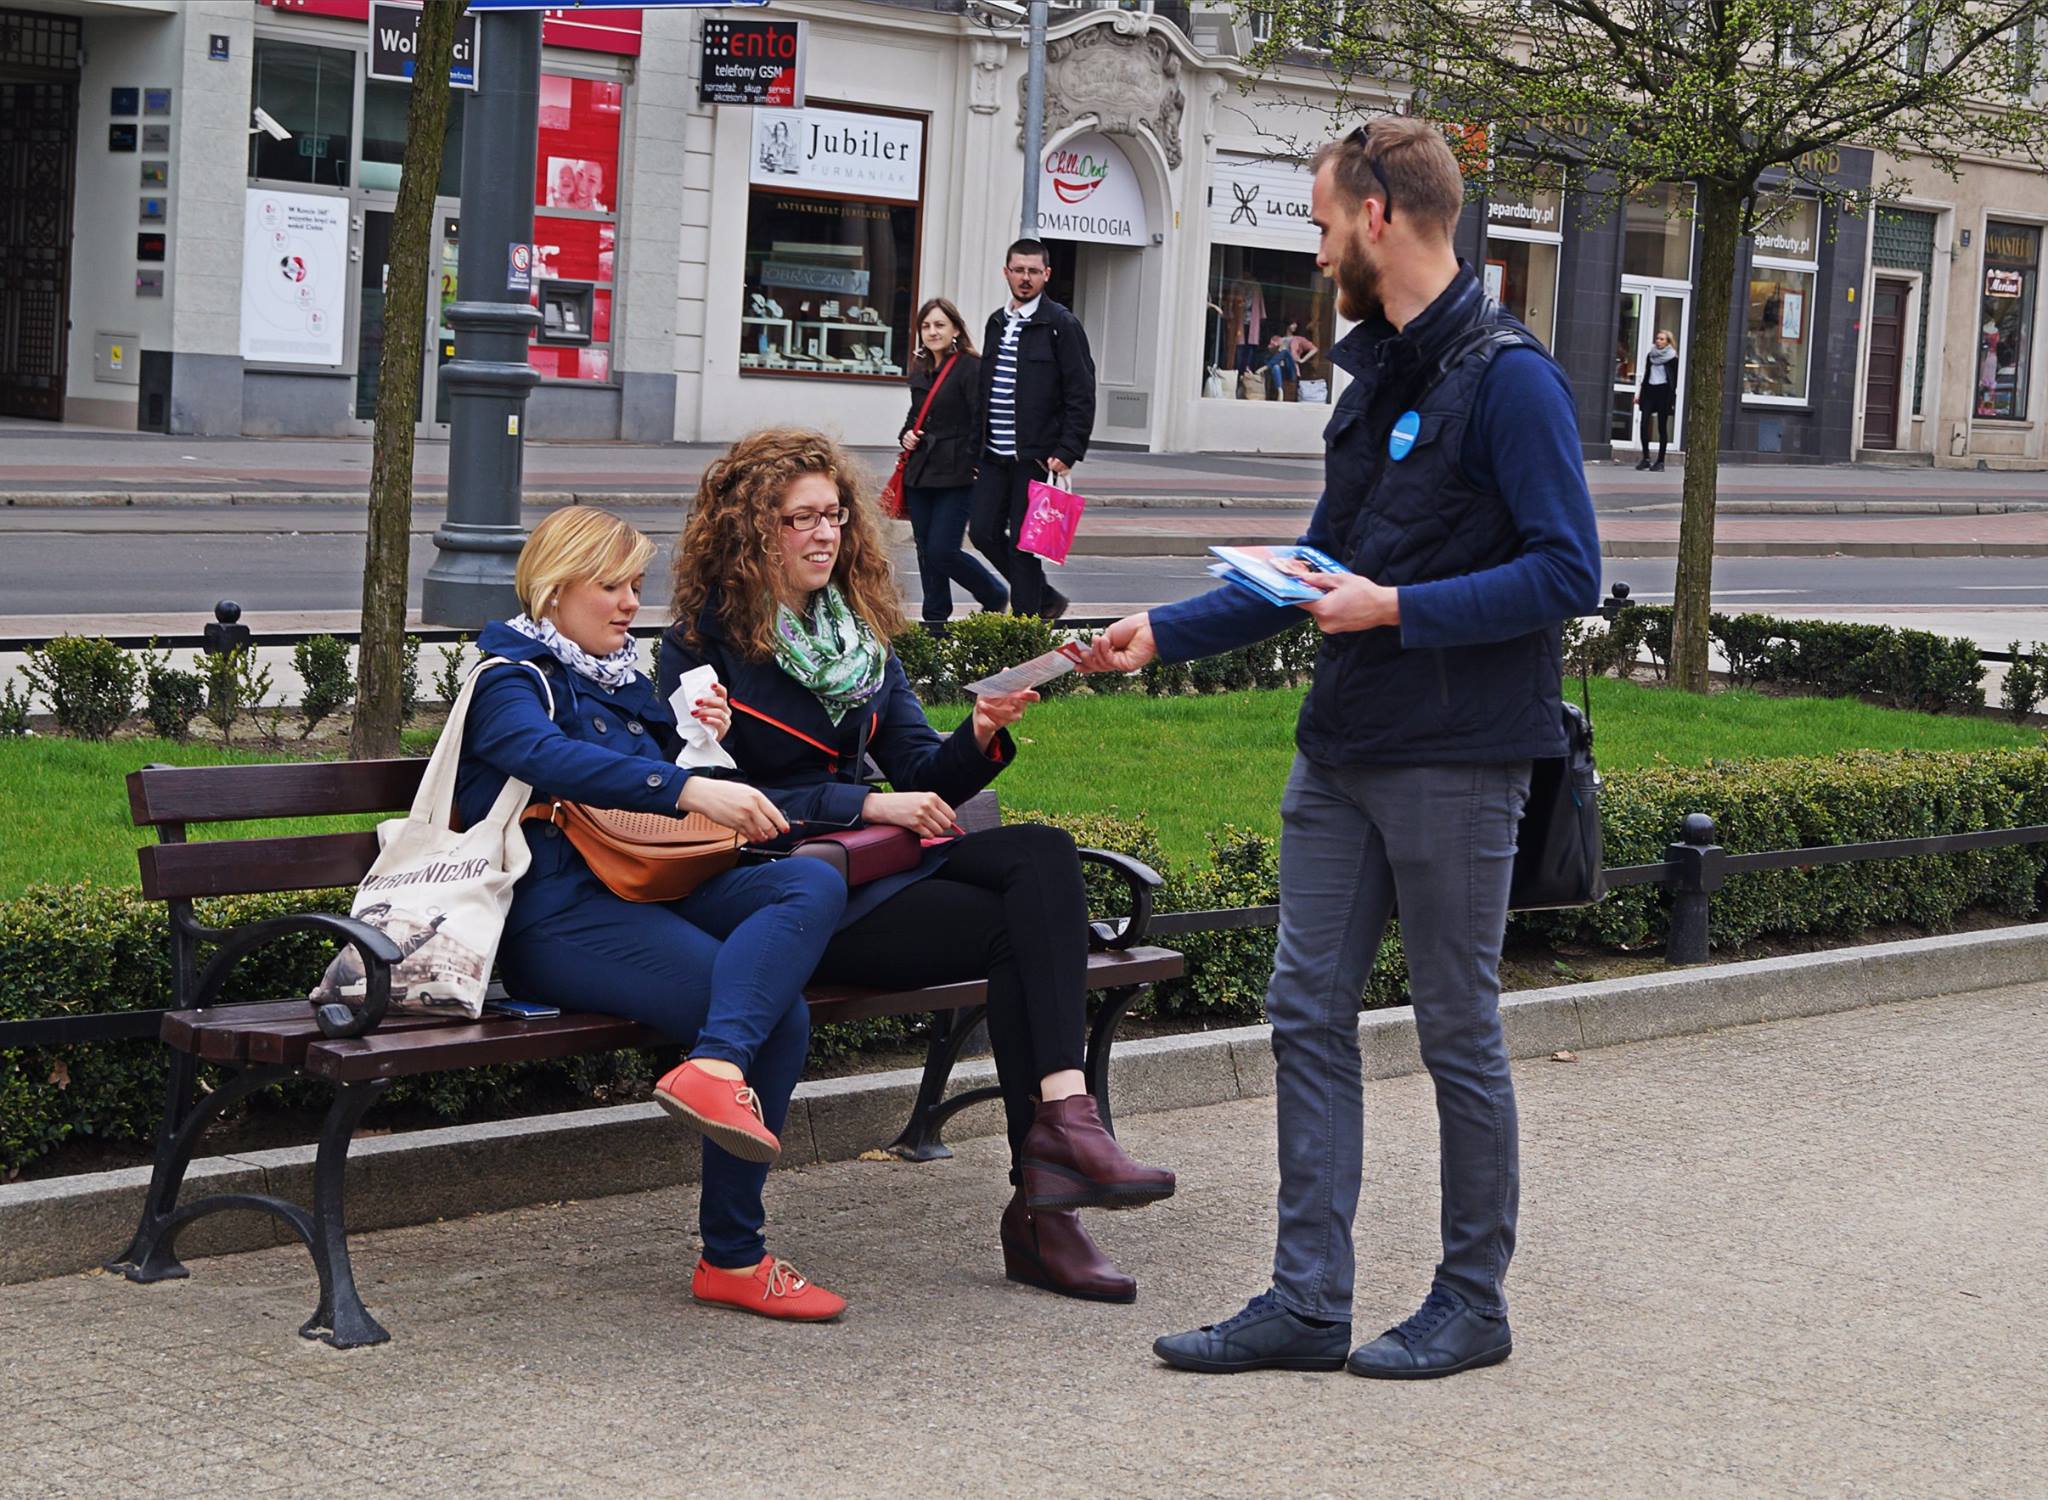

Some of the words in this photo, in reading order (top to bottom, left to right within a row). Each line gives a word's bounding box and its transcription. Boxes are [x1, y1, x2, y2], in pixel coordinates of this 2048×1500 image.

[380, 27, 468, 60] Wolci
[730, 26, 797, 58] ento
[715, 64, 756, 80] telefony
[759, 65, 783, 79] GSM
[744, 83, 762, 94] skup
[768, 86, 791, 95] serwis
[754, 94, 781, 104] simlock
[807, 123, 909, 162] Jubiler
[810, 164, 907, 184] FURMANIAK
[1266, 200, 1282, 215] LA
[1037, 212, 1132, 237] OMATOLOGIA
